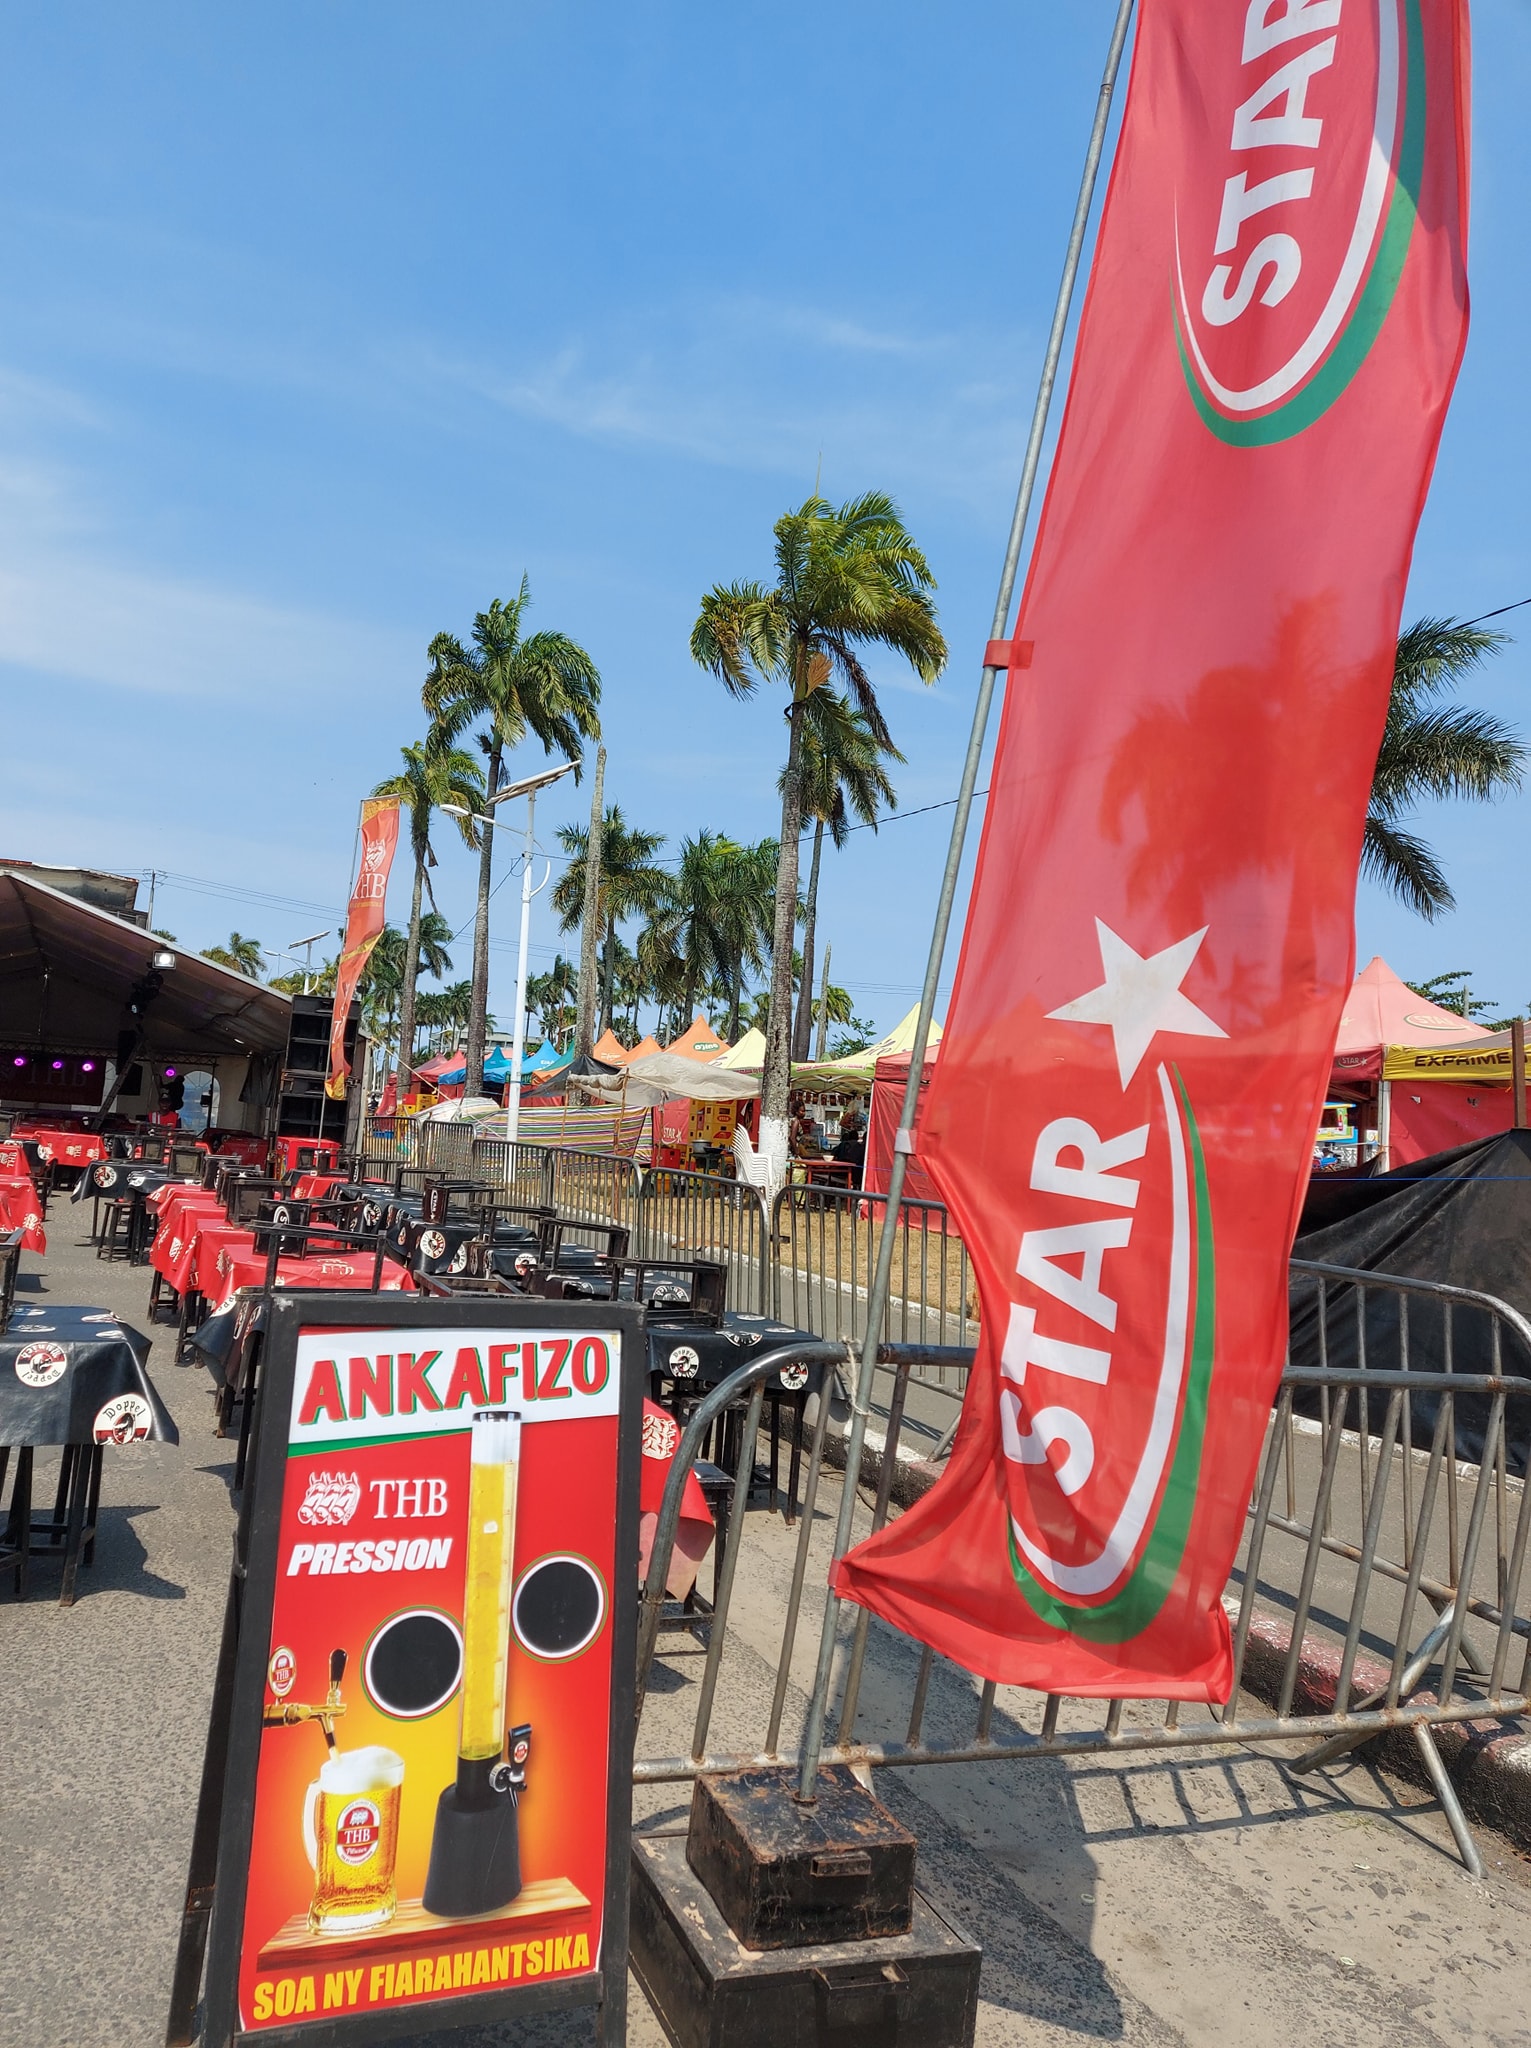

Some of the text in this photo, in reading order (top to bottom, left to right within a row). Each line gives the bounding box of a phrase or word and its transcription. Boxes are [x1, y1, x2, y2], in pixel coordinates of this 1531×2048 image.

[663, 1126, 676, 1139] STAR
[1001, 1116, 1151, 1496] STAR
[22, 1370, 61, 1383] Doppel
[298, 1337, 610, 1425] ANKAFIZO
[103, 1400, 146, 1421] Doppel
[369, 1479, 448, 1519] THB
[286, 1538, 453, 1577] PRESSION
[344, 1828, 371, 1845] THB
[253, 1933, 590, 2021] SOA NY FIARAHANTSIKA
